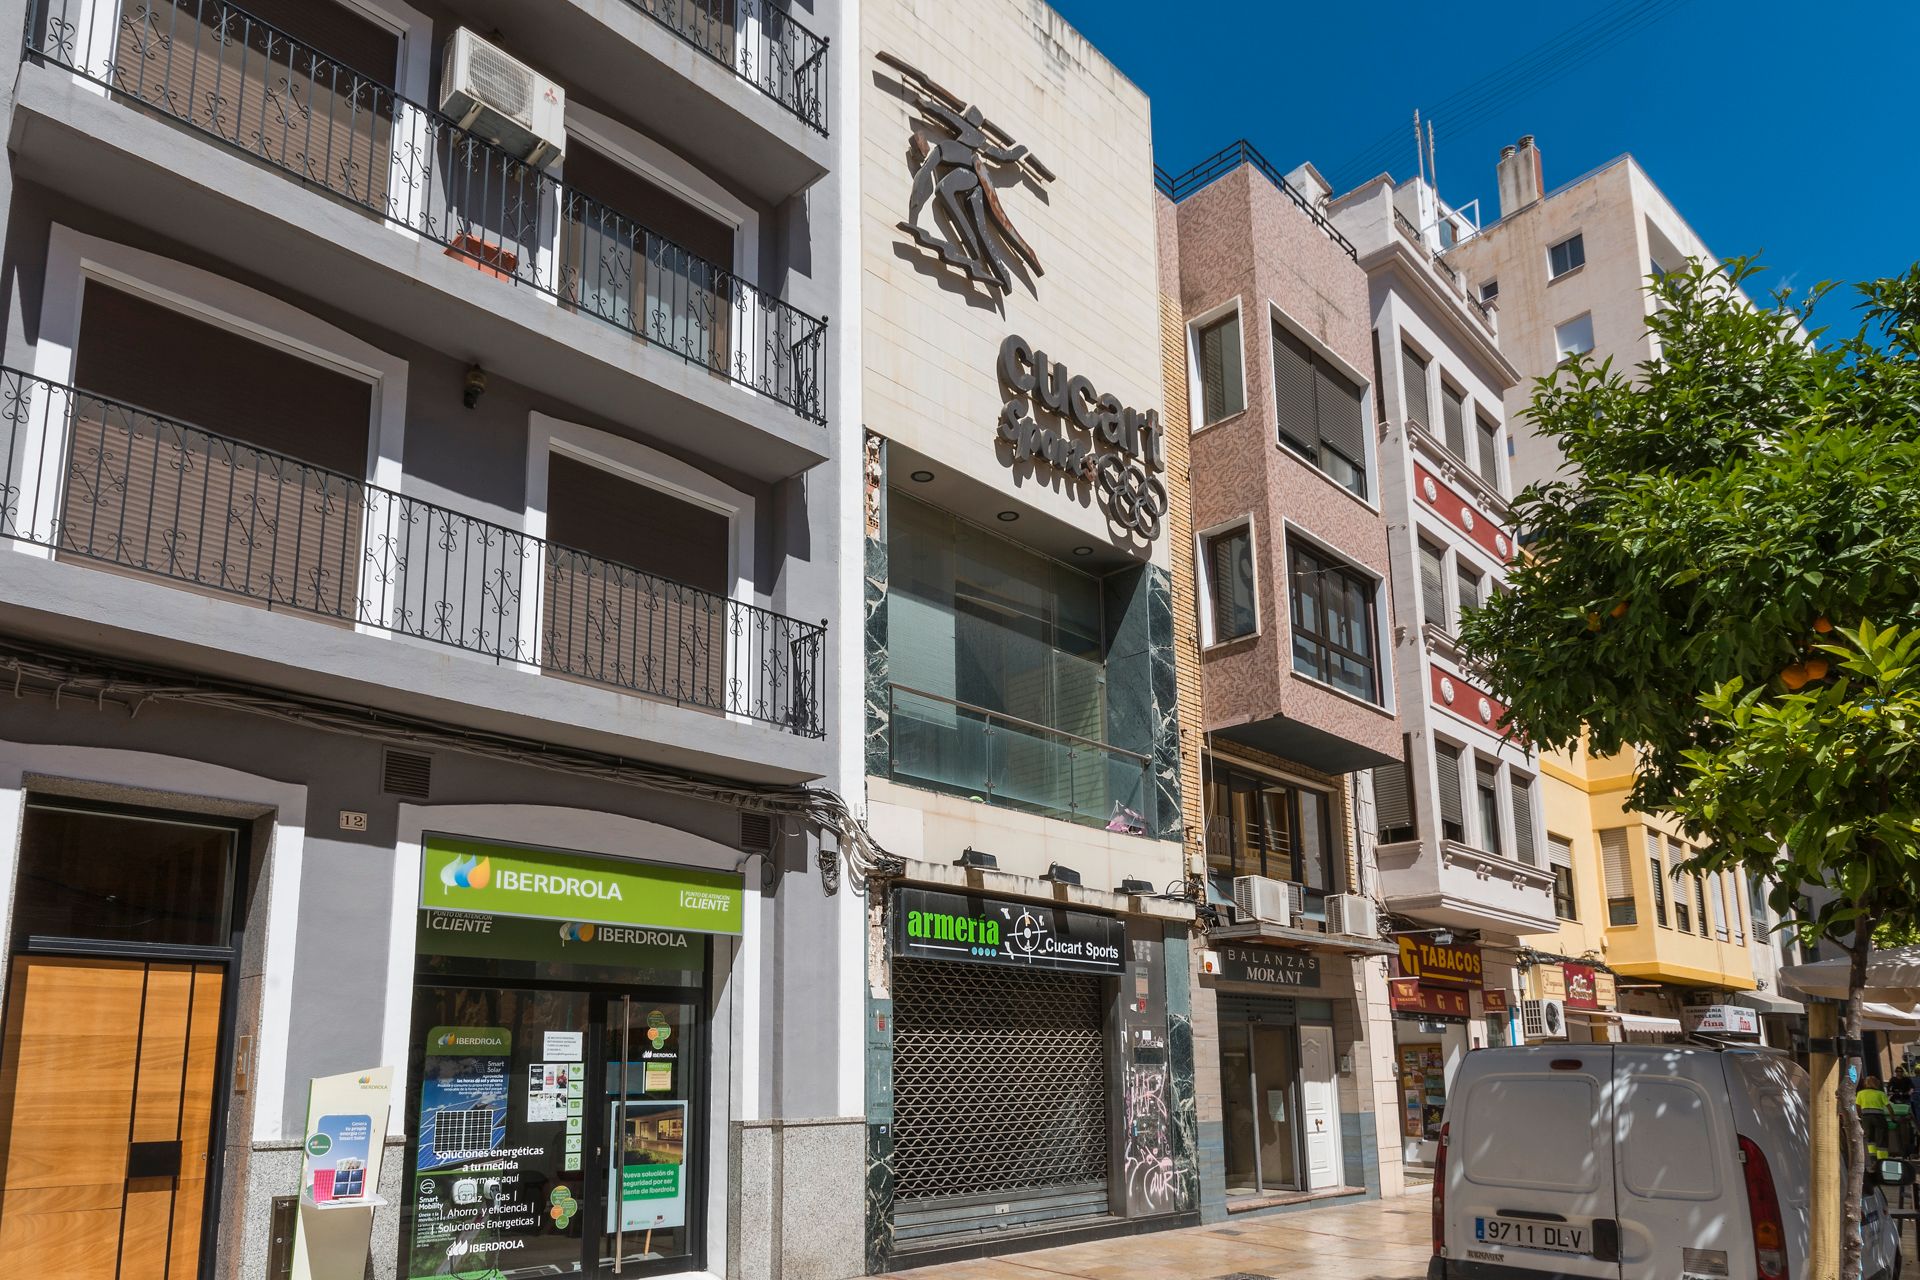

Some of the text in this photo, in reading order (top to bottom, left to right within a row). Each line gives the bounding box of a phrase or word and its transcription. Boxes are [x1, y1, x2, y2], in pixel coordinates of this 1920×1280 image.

[344, 815, 363, 827] 12
[496, 870, 623, 901] IBERDROLA
[685, 897, 730, 912] CLIENTE
[432, 916, 493, 933] CLIENTE
[907, 910, 1000, 946] armería
[598, 927, 688, 948] IBERDROLA
[1045, 937, 1119, 960] Cucart Sports
[1228, 950, 1316, 970] BALANZAS
[1420, 944, 1480, 974] TABACOS
[1246, 966, 1302, 984] MORANT
[456, 1038, 502, 1046] IBERDROLA
[436, 1146, 544, 1160] Soluciones energéticas
[470, 1163, 480, 1171] tu
[482, 1160, 519, 1171] medida
[501, 1174, 519, 1185] aquí
[418, 1202, 443, 1211] Mobility
[447, 1204, 528, 1218] Ahorro y eficiencia
[438, 1222, 485, 1233] Soluciones
[1488, 1222, 1582, 1248] 9711 DLV
[469, 1240, 524, 1253] IBERDROLA
